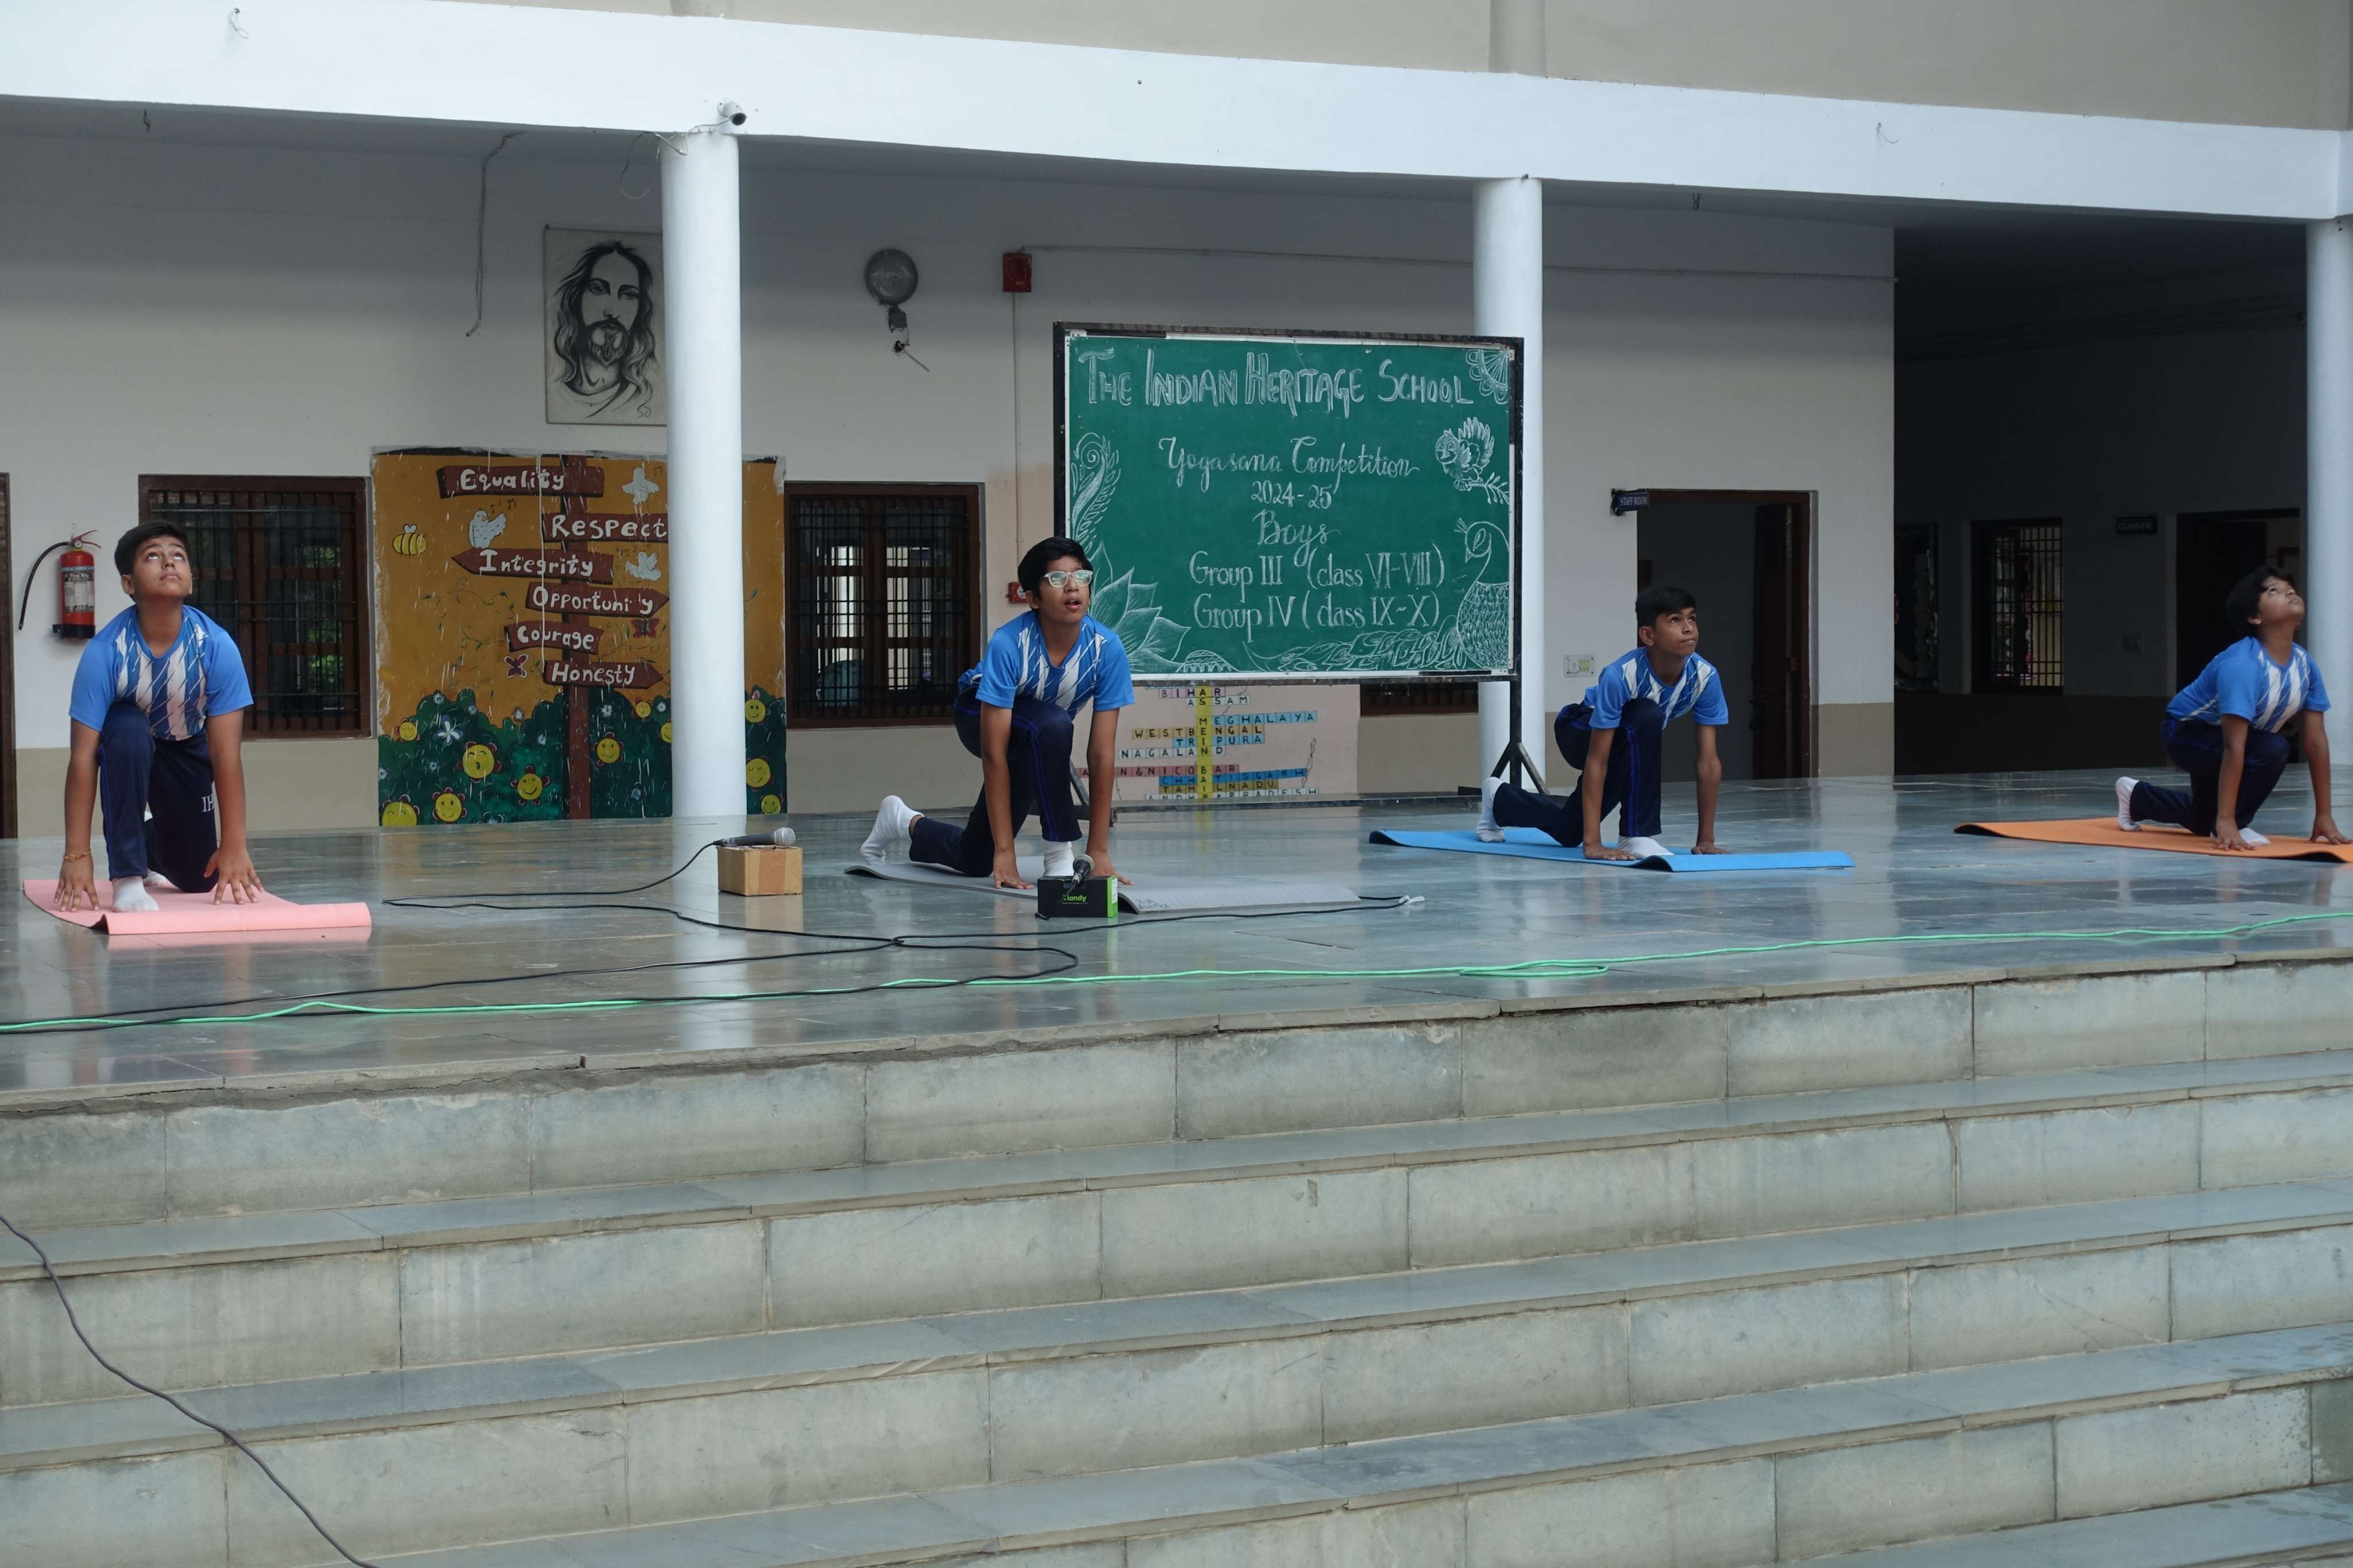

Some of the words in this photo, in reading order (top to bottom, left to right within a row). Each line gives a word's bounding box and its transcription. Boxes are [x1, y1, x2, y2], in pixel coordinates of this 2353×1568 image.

[1078, 347, 1131, 405] THE
[1145, 349, 1237, 407] INDIAN
[1245, 352, 1364, 419] HERITAGE
[1378, 359, 1474, 404] SCHOOL
[1158, 437, 1283, 492] Yogasana
[1290, 436, 1420, 493] Competition
[460, 468, 565, 492] Equality
[1251, 480, 1332, 509] 2024-25
[1620, 497, 1634, 506] STAFF
[551, 515, 668, 539] Respect
[1252, 509, 1341, 567] Boys
[479, 549, 593, 577] Integrity
[1190, 551, 1253, 603] Group
[1259, 555, 1284, 586] III
[533, 586, 653, 615] Opportuniy
[1194, 593, 1263, 643] Group
[1267, 596, 1297, 627] IV
[517, 625, 595, 650] Courage
[551, 661, 635, 685] Honesty
[1162, 688, 1221, 698] BIHAR
[1188, 696, 1248, 706] ASSAM
[1199, 713, 1314, 725] MEGHALAYA
[1121, 747, 1222, 758] NAGALAND
[1176, 736, 1262, 747] TRIPURA
